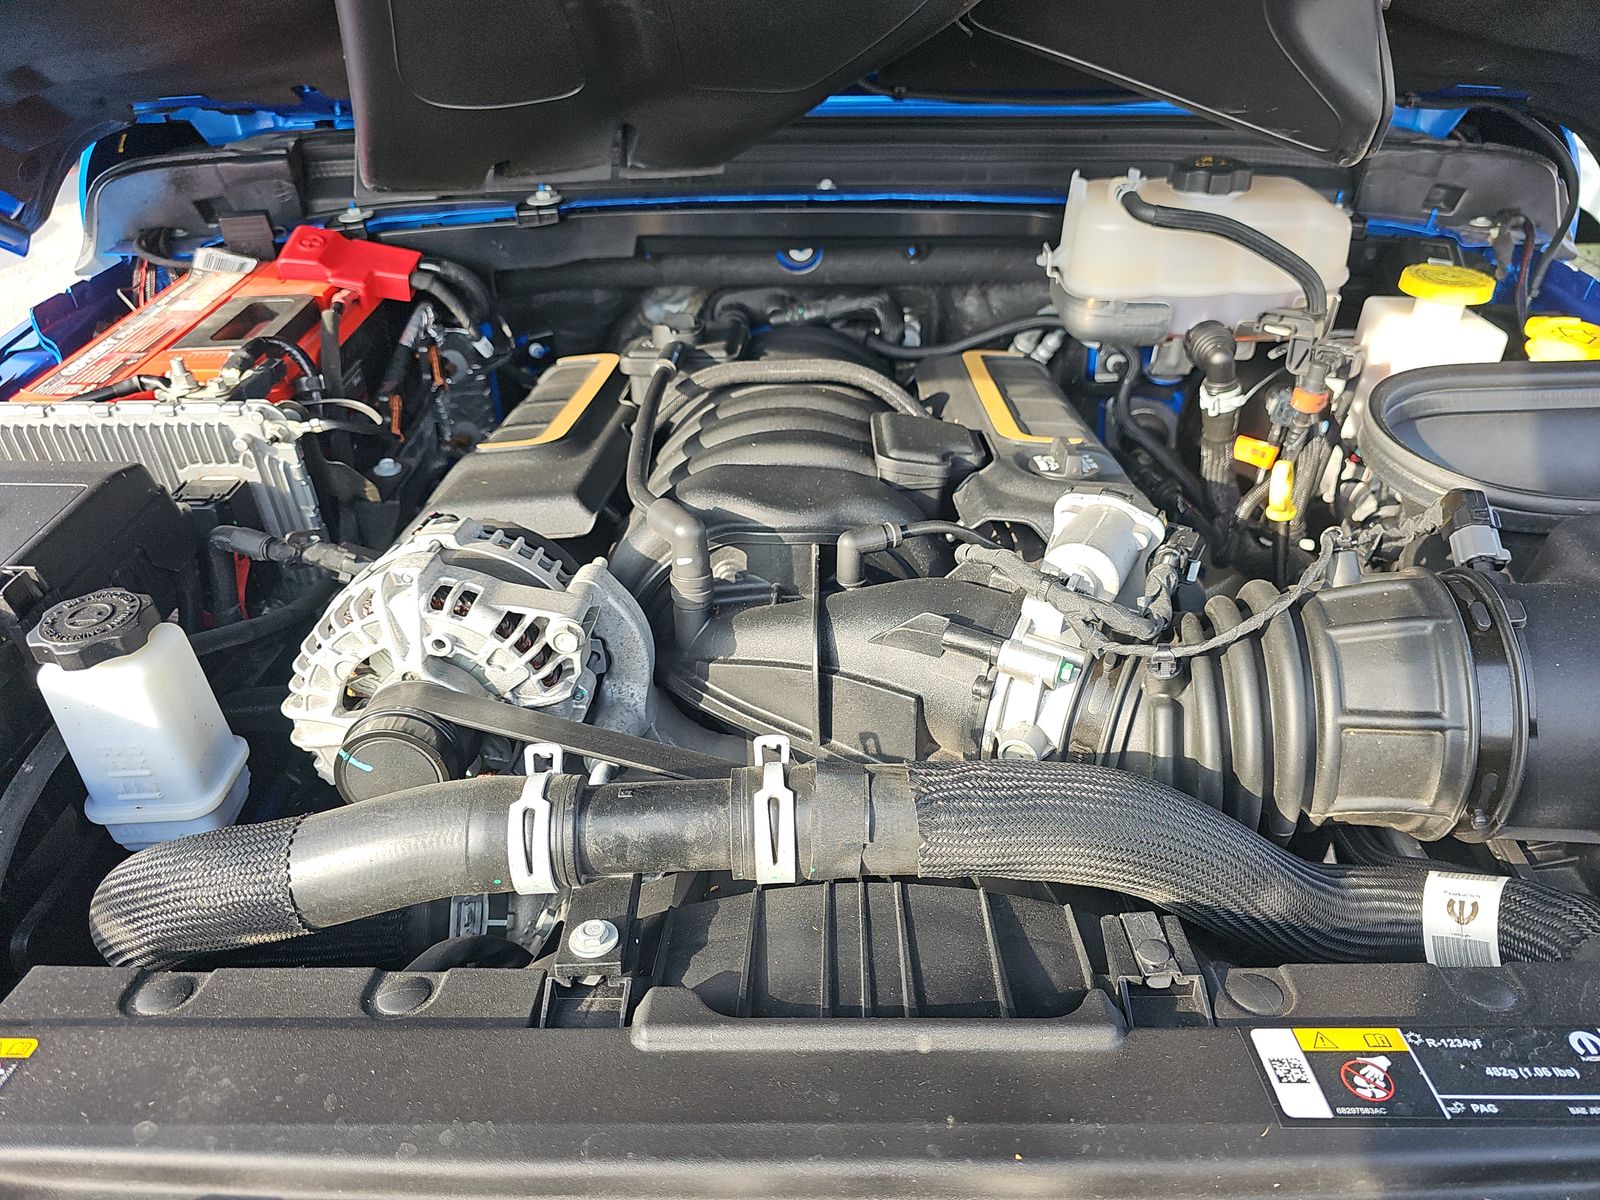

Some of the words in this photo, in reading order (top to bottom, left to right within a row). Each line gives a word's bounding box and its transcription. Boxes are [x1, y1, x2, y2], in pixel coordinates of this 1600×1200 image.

[1425, 1038, 1483, 1050] R-1234yf
[1485, 1066, 1519, 1079] 482g
[1519, 1066, 1552, 1079] (1.06
[1551, 1066, 1580, 1080] lbs)
[1470, 1103, 1499, 1114] PAG
